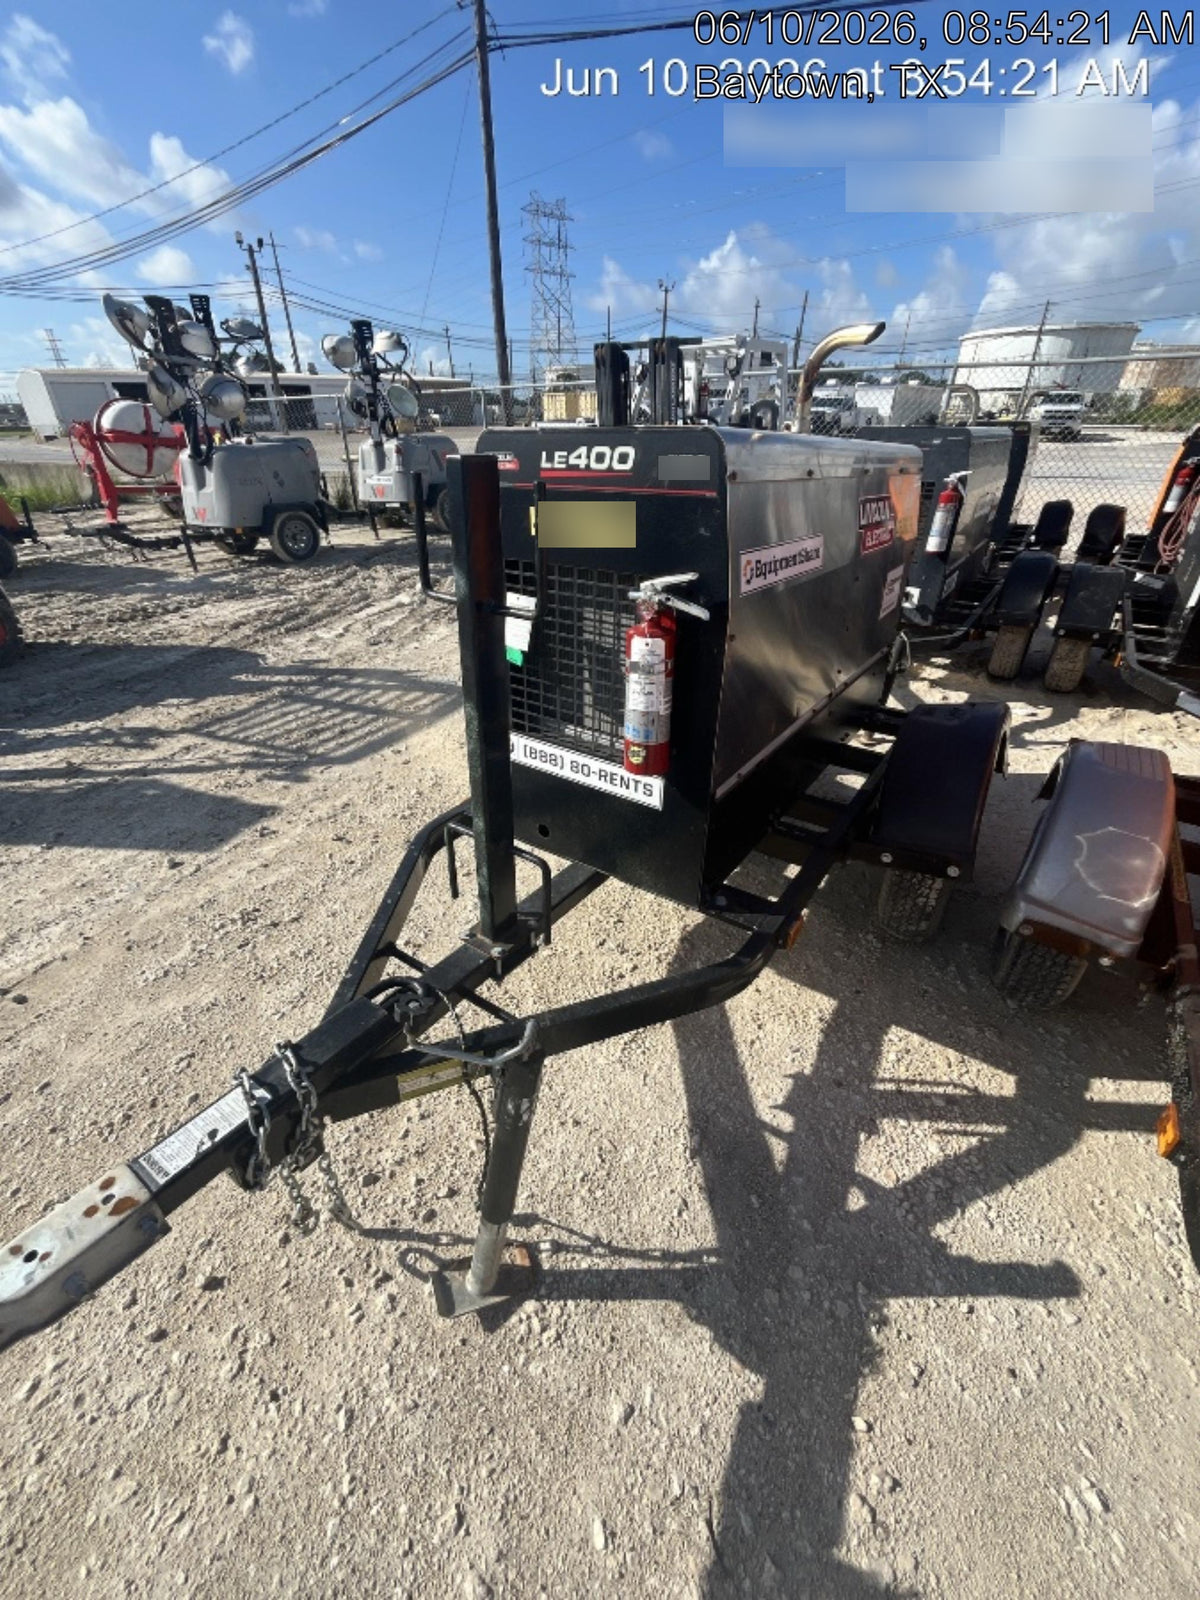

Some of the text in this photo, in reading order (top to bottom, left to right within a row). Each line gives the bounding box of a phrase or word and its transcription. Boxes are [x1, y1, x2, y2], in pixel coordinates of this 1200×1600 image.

[540, 446, 635, 470] LE400
[755, 547, 820, 580] EquipmentShare
[523, 744, 565, 770] (888)
[569, 759, 654, 798] 80-RENTS
